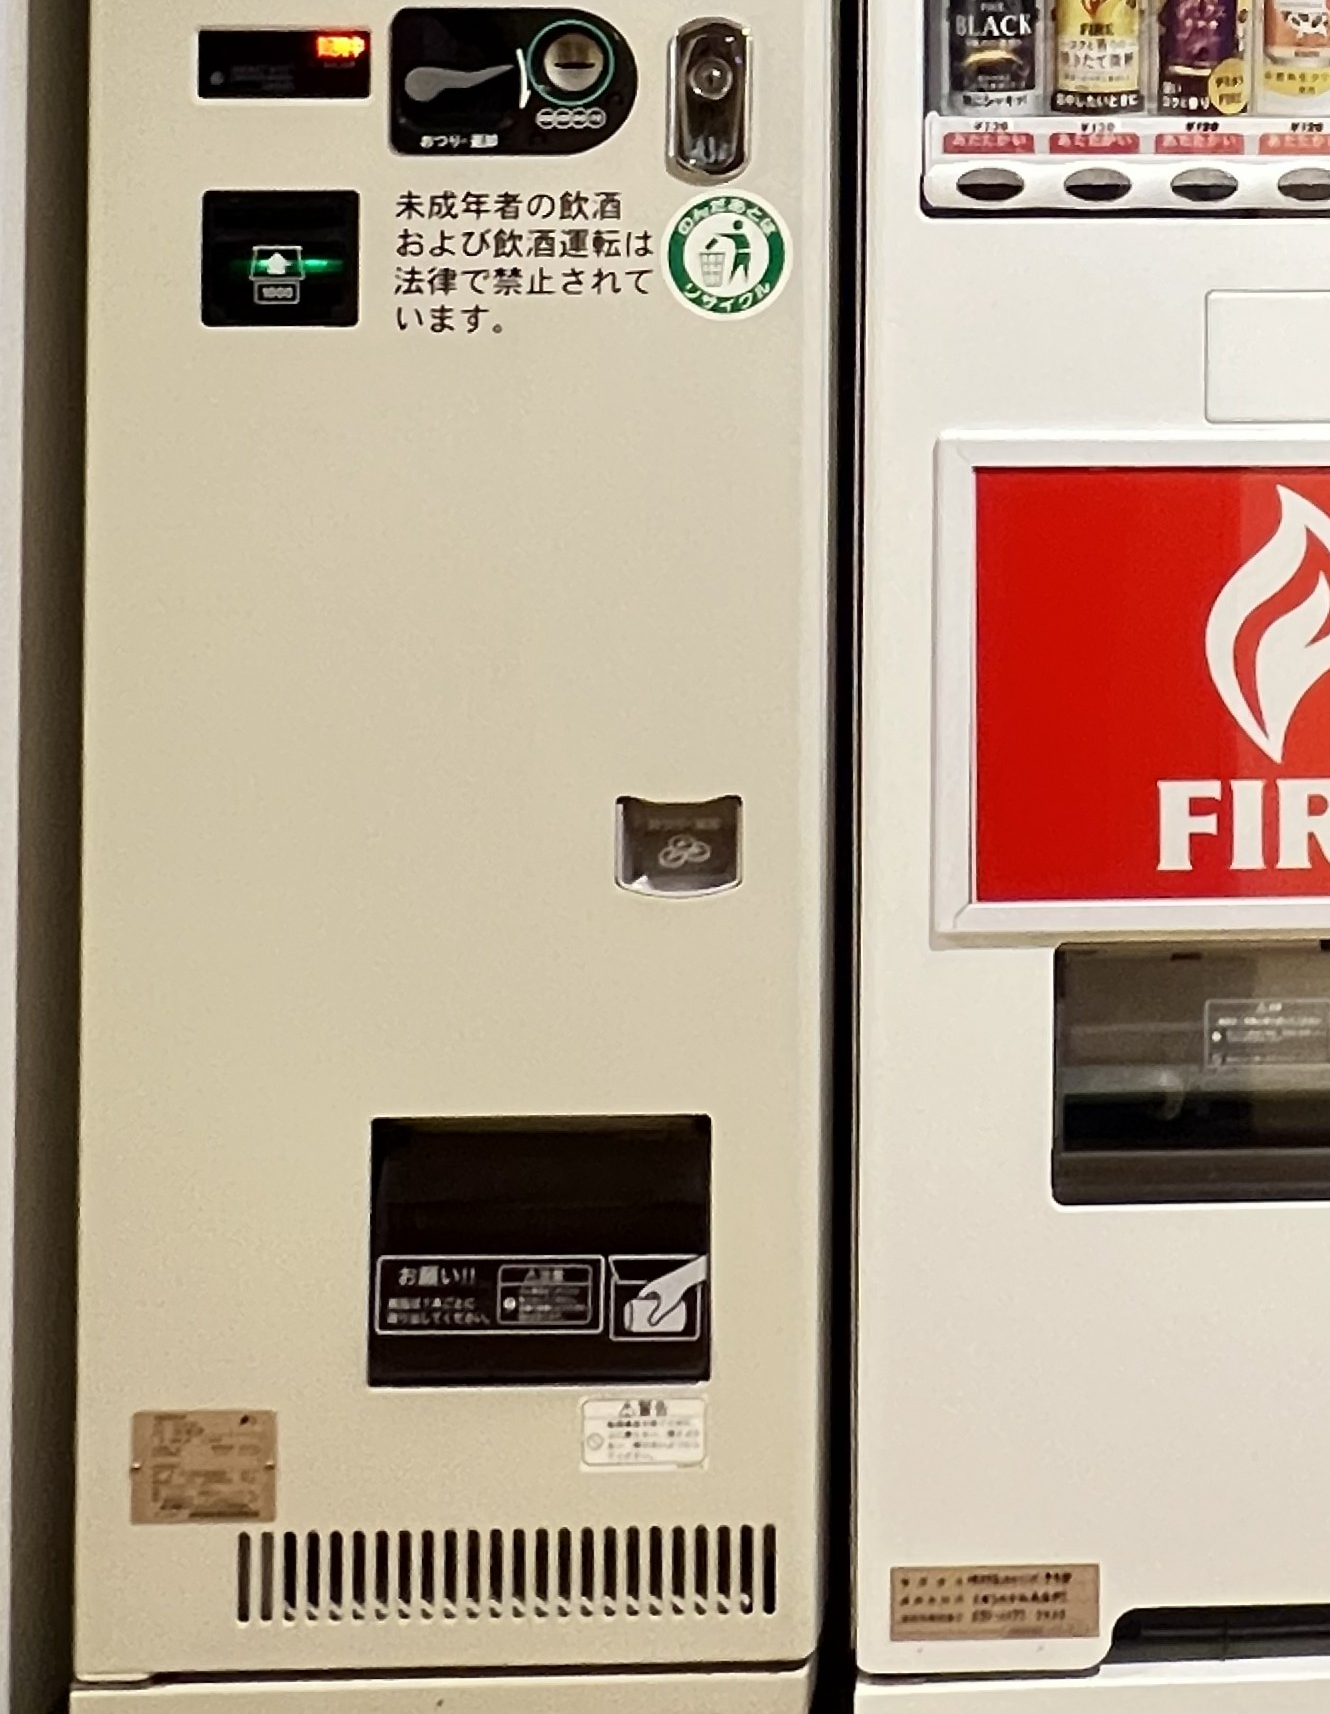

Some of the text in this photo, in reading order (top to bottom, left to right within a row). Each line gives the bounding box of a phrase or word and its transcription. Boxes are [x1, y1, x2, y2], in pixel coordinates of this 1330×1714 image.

[955, 13, 1033, 36] BLACK
[395, 191, 621, 222] 未成年者の飲酒
[395, 229, 654, 259] および飲酒運転は
[394, 267, 653, 297] 法律で禁止されて
[683, 282, 771, 313] リサイクル
[395, 304, 504, 334] います。
